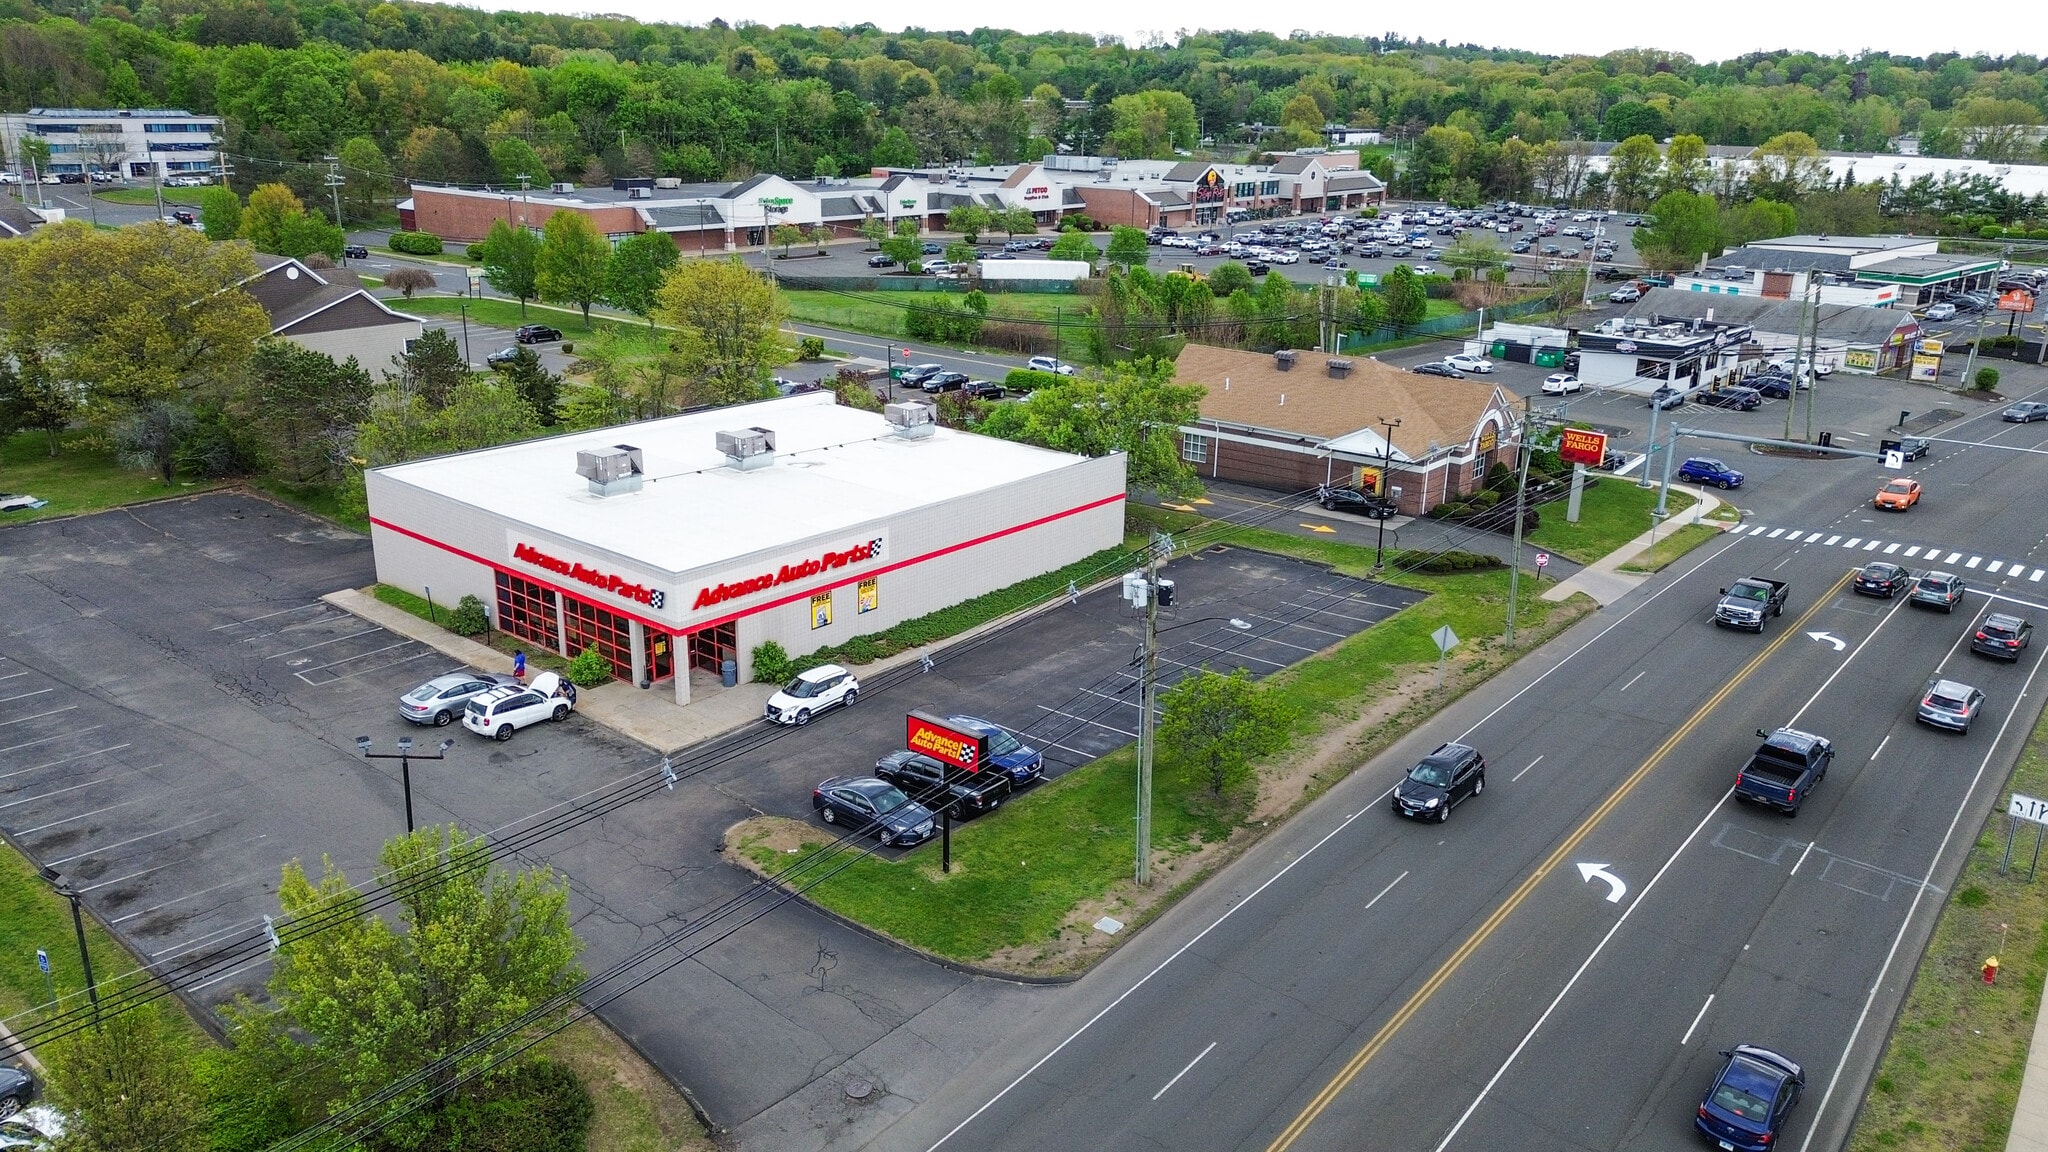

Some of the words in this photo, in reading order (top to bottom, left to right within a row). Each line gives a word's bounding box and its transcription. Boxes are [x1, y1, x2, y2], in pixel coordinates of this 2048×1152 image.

[1565, 441, 1599, 452] FARGO
[1566, 433, 1600, 445] WELLS
[513, 543, 571, 576] Advance
[569, 563, 608, 589] Auto
[607, 574, 651, 605] Parts
[692, 573, 774, 610] Advance
[773, 559, 820, 586] Auto
[859, 578, 876, 589] FREE
[812, 592, 830, 604] FREE
[915, 727, 959, 750] Advance
[910, 736, 933, 749] Auto
[933, 743, 957, 759] Parts
